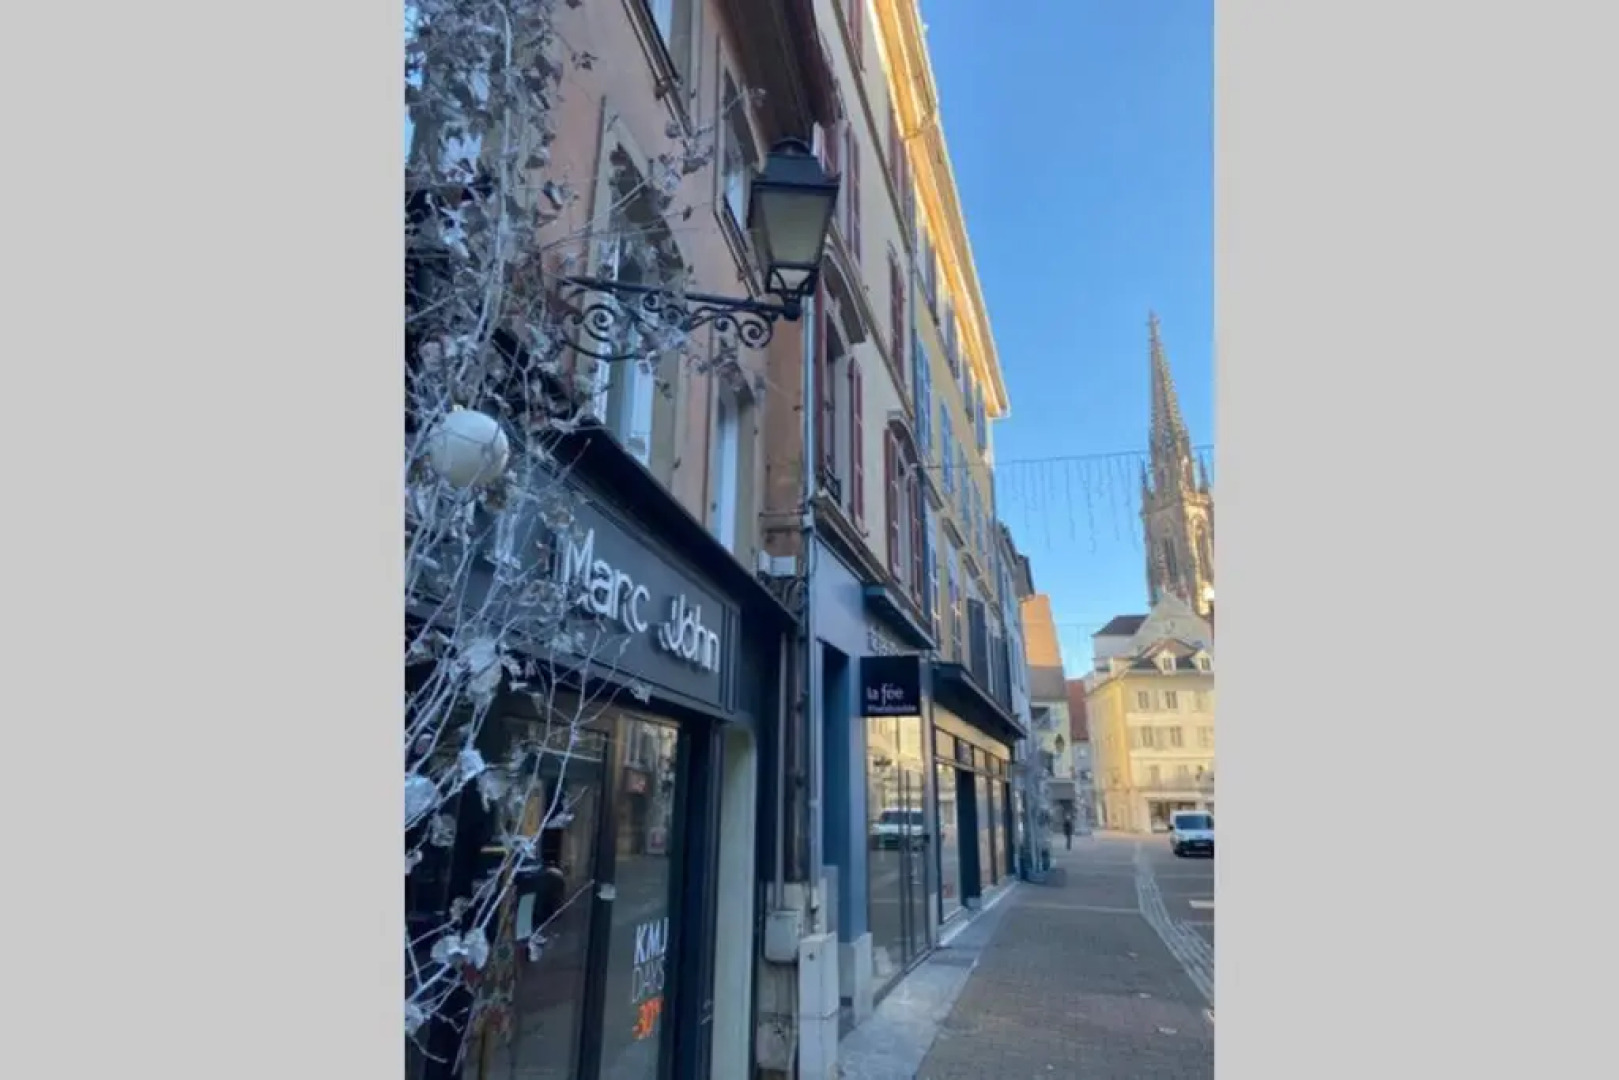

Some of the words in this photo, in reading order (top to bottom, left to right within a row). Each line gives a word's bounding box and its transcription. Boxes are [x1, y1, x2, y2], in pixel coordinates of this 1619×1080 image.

[559, 528, 650, 633] Marc
[658, 594, 719, 672] John
[866, 686, 879, 700] la
